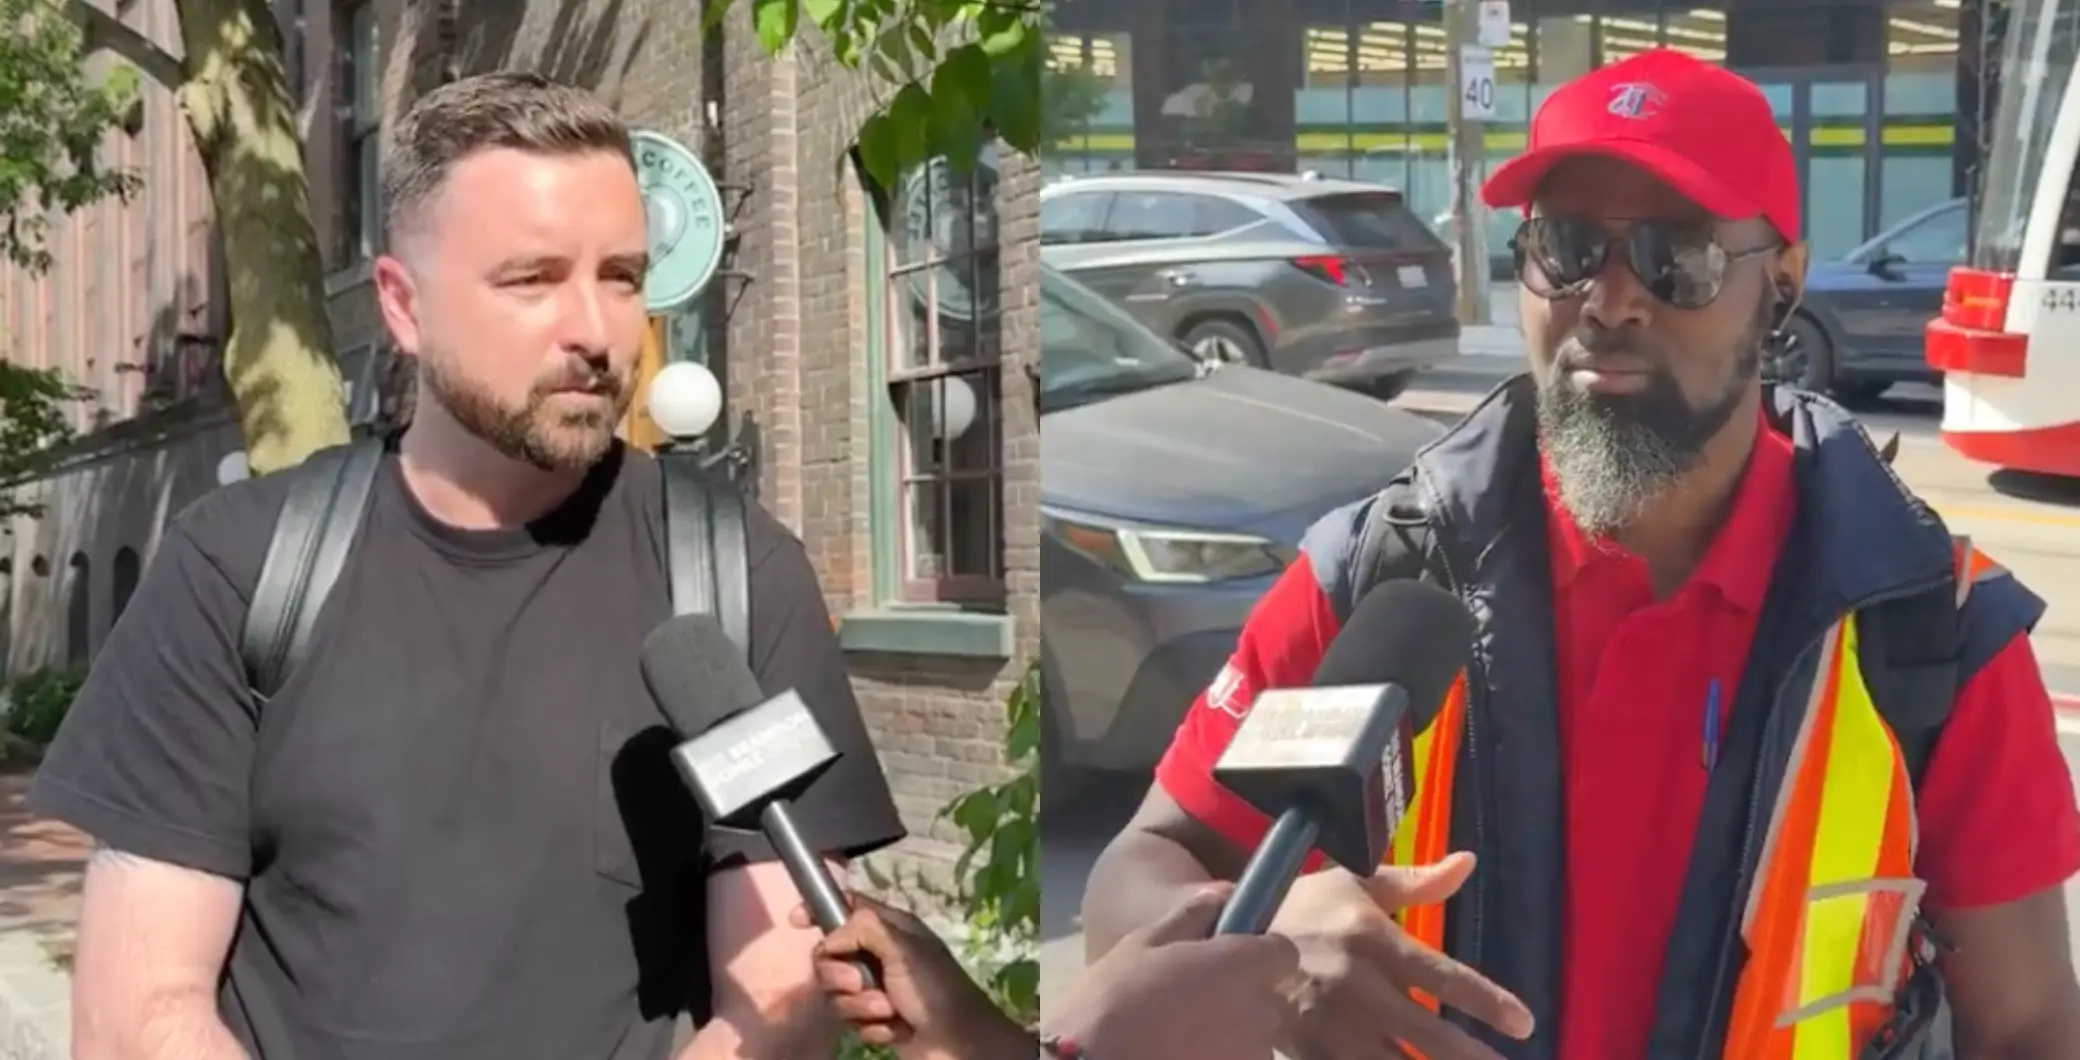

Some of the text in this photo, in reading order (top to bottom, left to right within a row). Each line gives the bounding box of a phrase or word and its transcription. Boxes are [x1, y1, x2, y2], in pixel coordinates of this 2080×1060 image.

[1465, 77, 1494, 109] 40
[641, 150, 710, 230] COFFEE
[2042, 289, 2080, 313] 44
